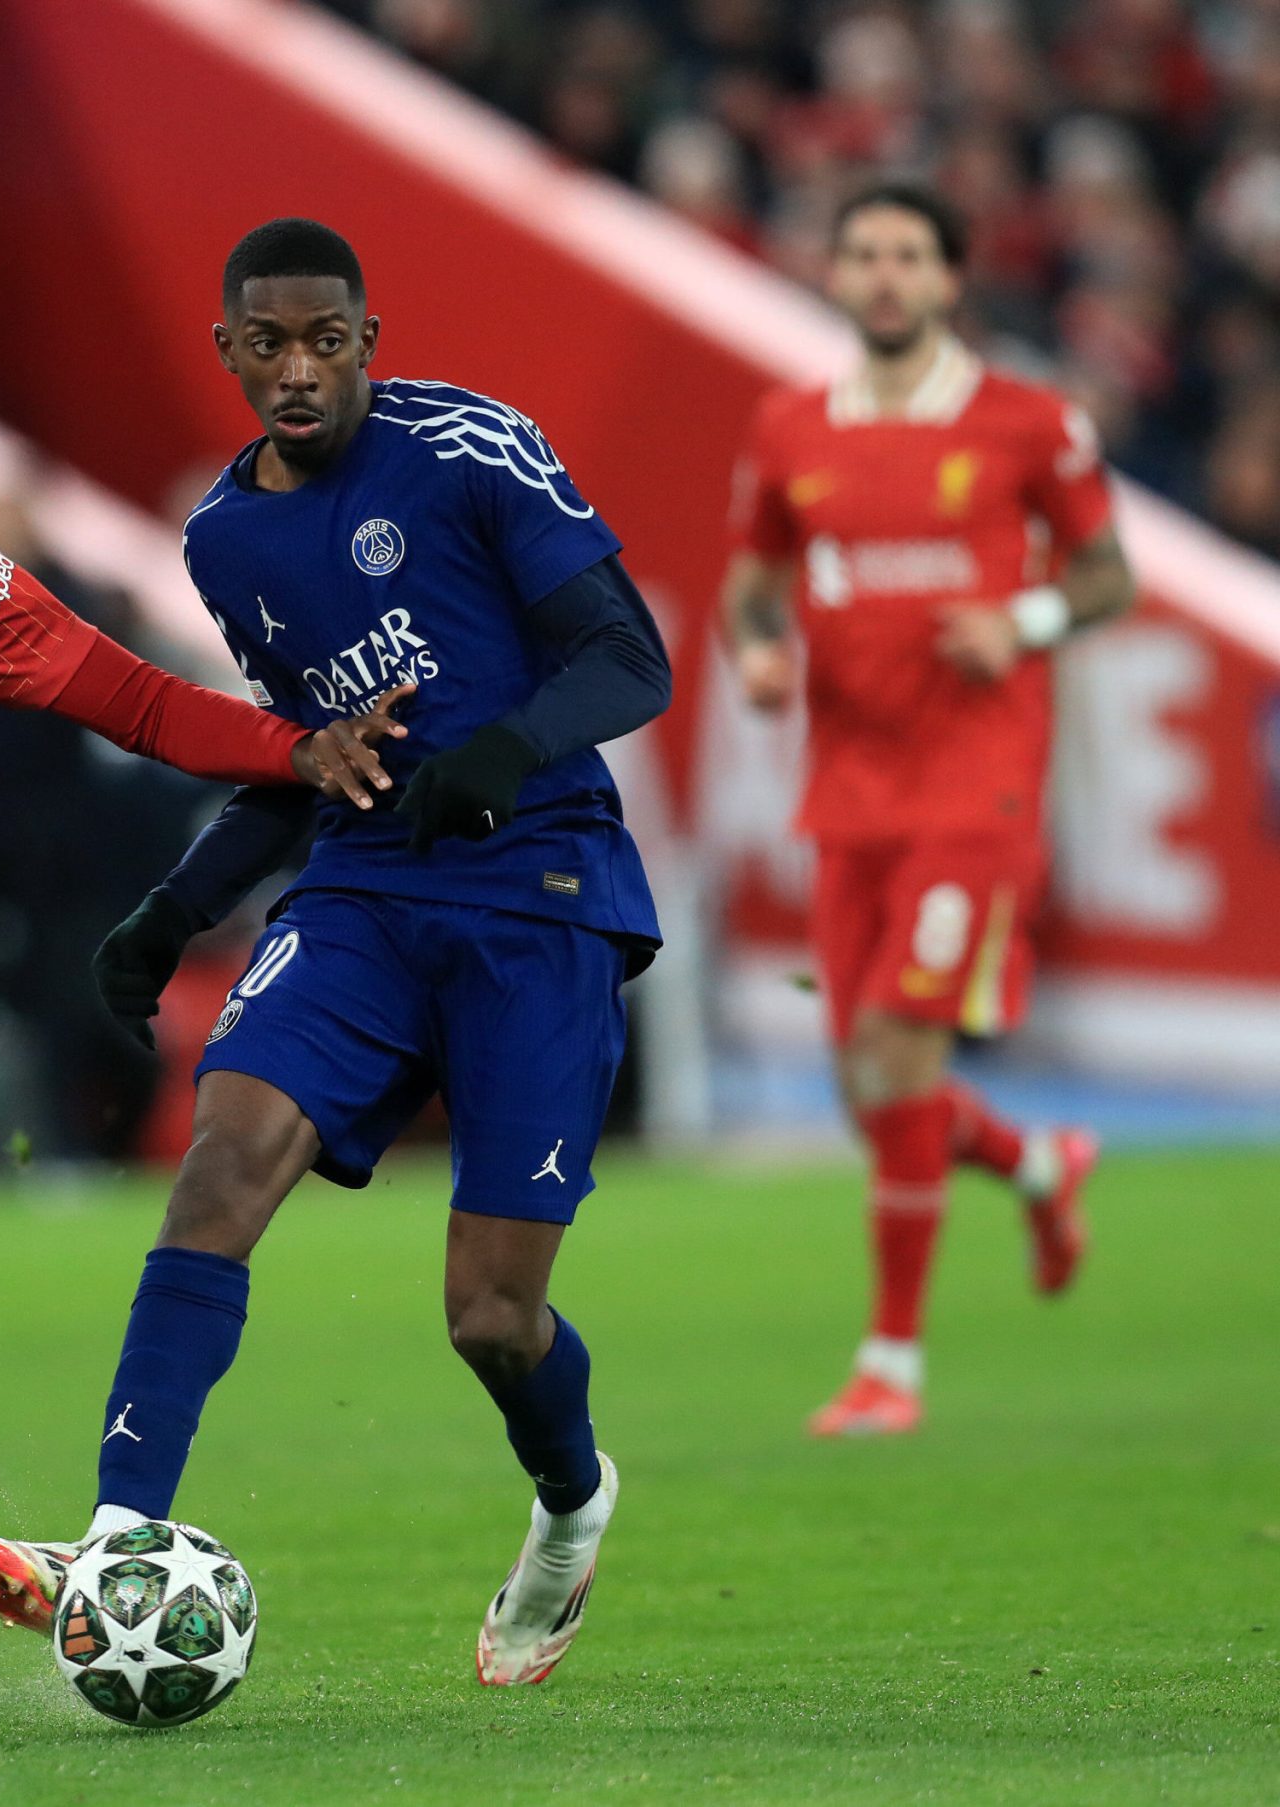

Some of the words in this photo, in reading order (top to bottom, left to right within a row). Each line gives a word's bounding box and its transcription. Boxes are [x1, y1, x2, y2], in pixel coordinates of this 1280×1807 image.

[357, 521, 389, 541] PARIS
[303, 608, 428, 713] QATAR
[350, 651, 439, 716] IAYS
